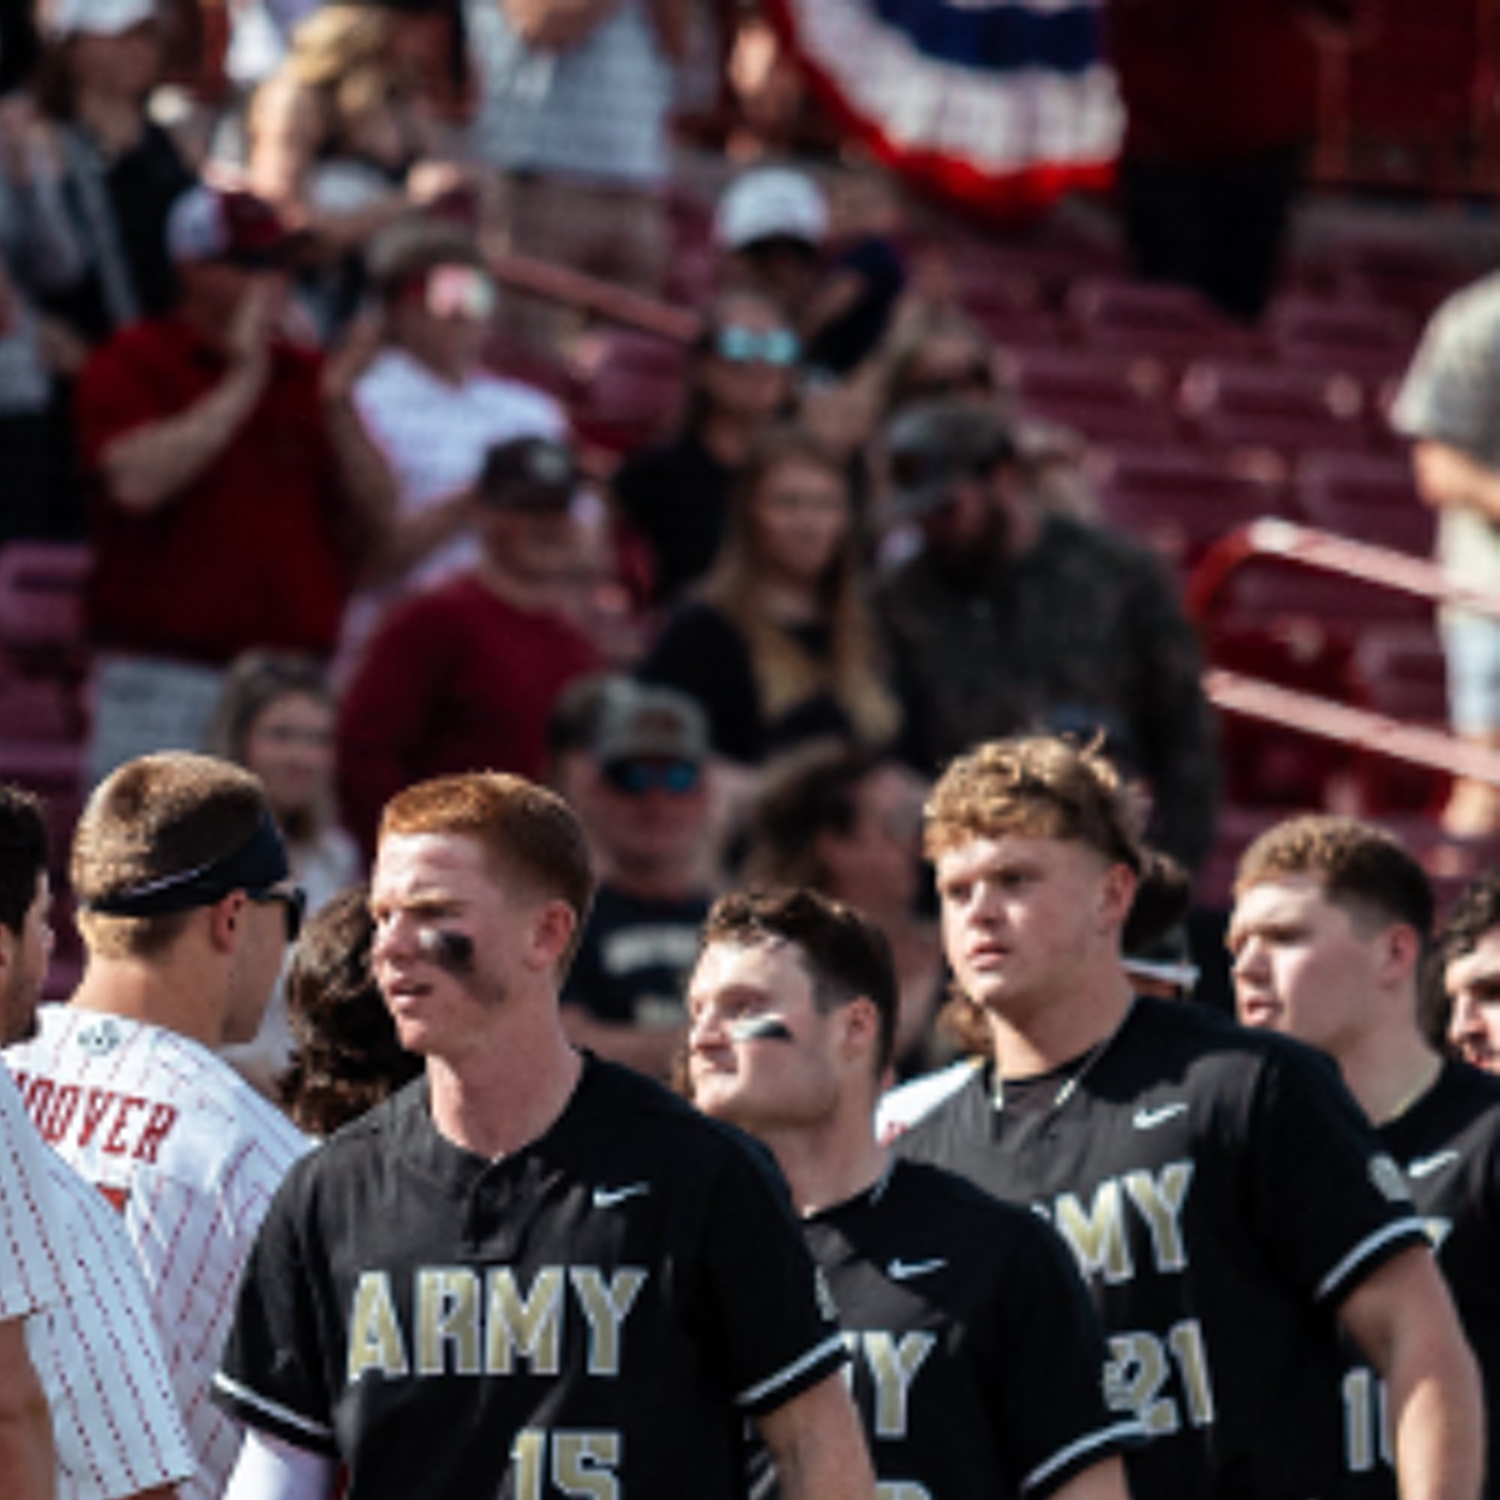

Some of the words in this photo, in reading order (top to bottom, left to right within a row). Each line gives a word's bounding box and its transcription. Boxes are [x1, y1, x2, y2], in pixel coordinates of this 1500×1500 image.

[14, 1071, 179, 1165] OOVER
[346, 1264, 649, 1386] ARMY
[1105, 1316, 1215, 1434] 21
[1342, 1365, 1395, 1471] 1
